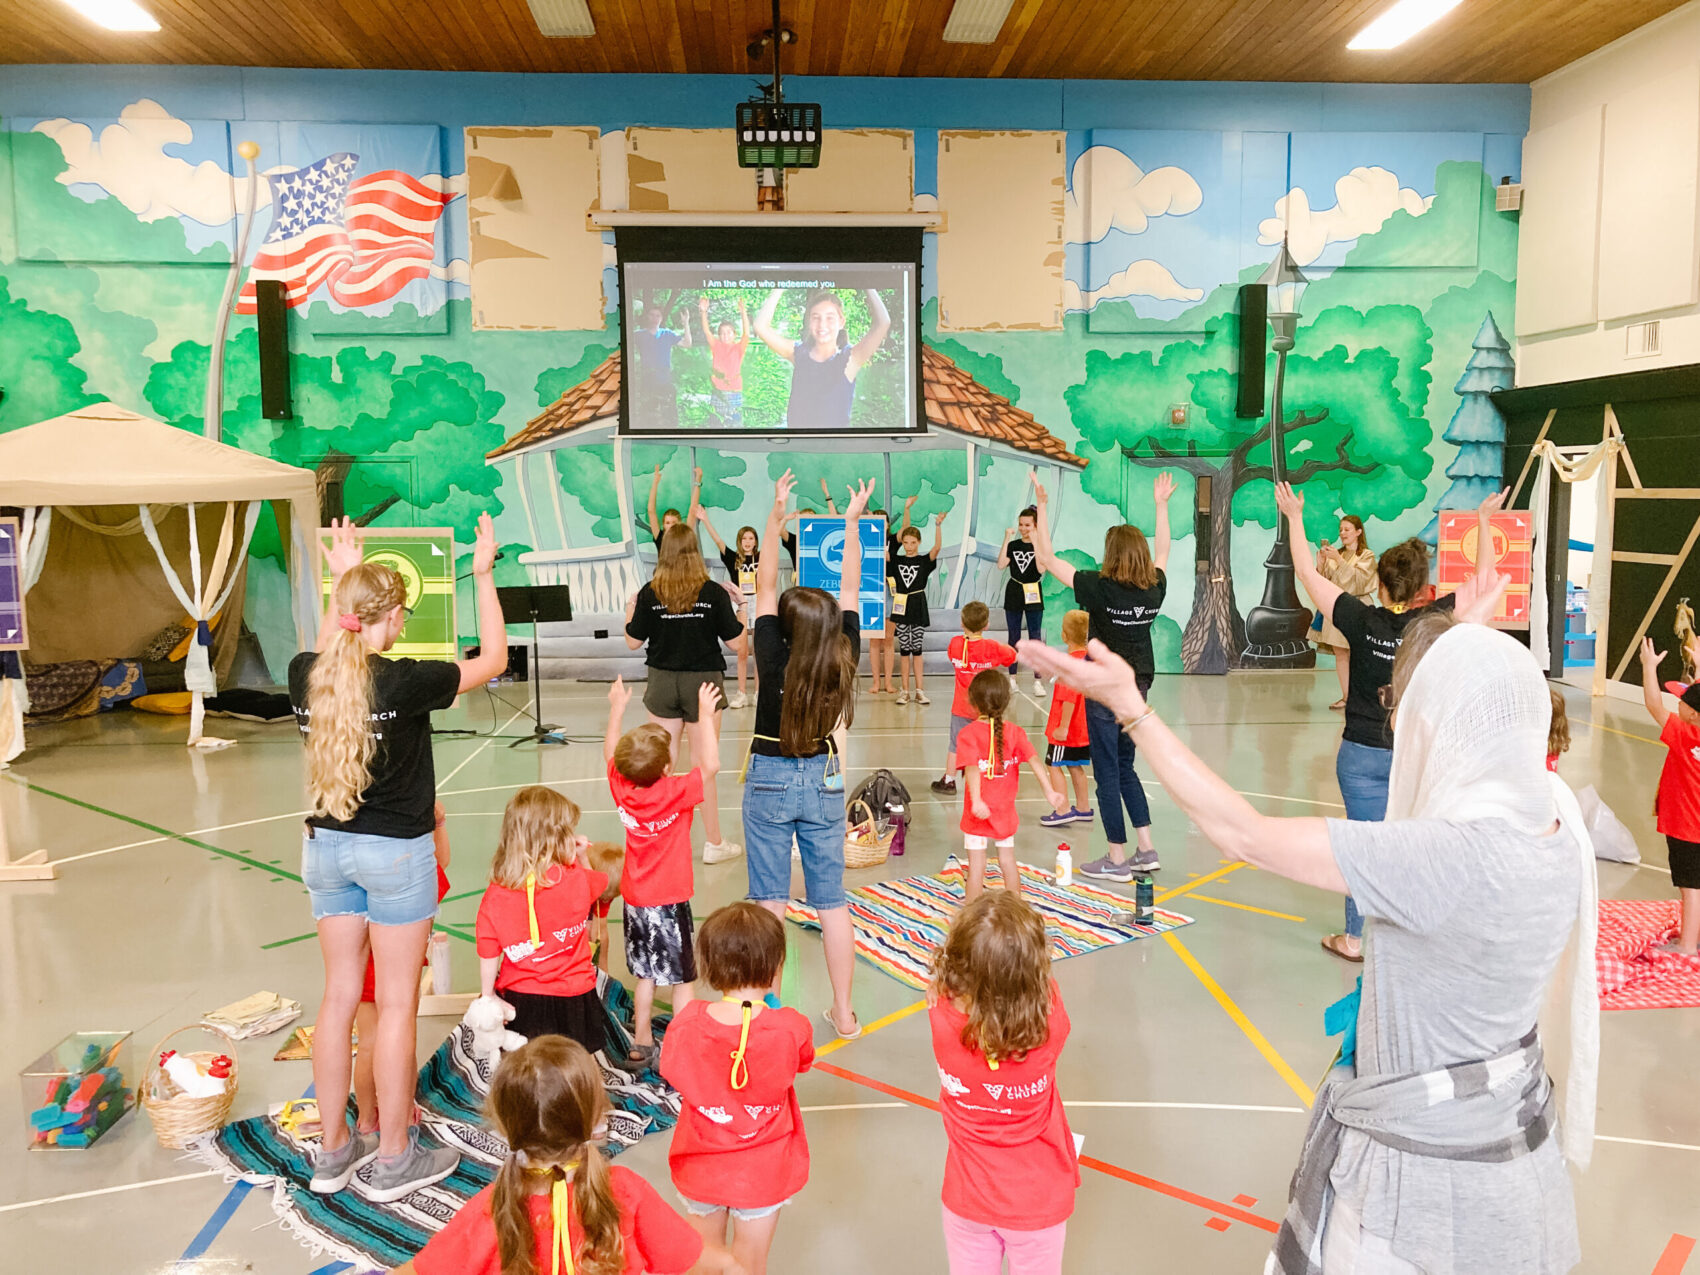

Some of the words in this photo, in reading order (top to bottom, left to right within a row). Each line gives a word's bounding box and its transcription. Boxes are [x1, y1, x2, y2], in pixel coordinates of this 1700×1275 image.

[708, 280, 721, 288] Am
[724, 280, 737, 288] the
[739, 280, 757, 288] God
[759, 280, 776, 288] who
[778, 280, 818, 288] redeemed
[820, 282, 835, 290] you
[1106, 606, 1132, 615] VILLAGE
[1366, 634, 1395, 648] VILLAGE
